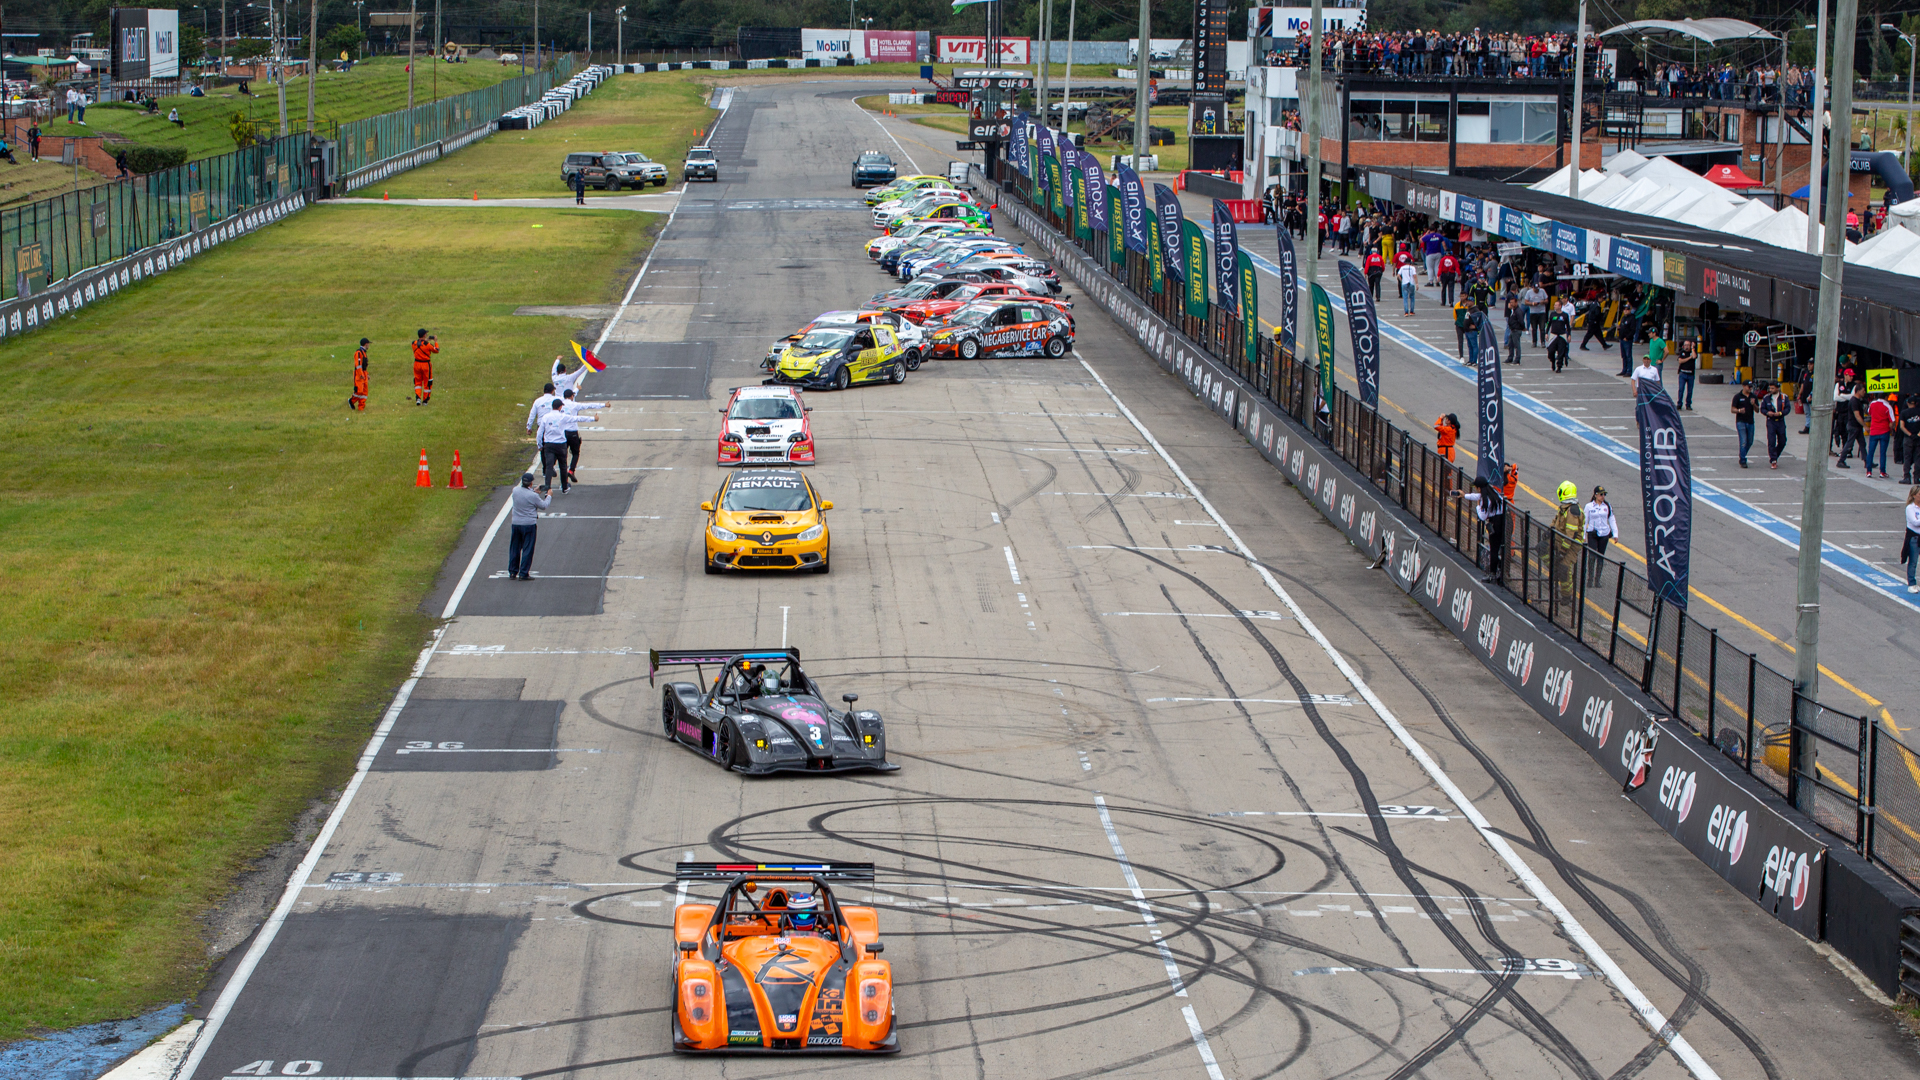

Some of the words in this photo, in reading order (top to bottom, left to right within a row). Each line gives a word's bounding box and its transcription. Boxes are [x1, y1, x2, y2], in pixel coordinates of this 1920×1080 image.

[1200, 9, 1207, 17] 3
[1200, 19, 1206, 27] 4
[1288, 18, 1326, 30] Mol
[1331, 18, 1343, 30] 1
[816, 40, 841, 51] Mobil
[842, 40, 850, 52] 1
[1199, 30, 1206, 38] 5
[1199, 40, 1205, 48] 6
[1198, 61, 1205, 69] 8
[1199, 51, 1205, 59] 7
[960, 79, 980, 88] elf
[998, 79, 1018, 88] elf
[1196, 82, 1205, 90] 10
[1198, 72, 1204, 80] 9
[974, 125, 997, 136] elf
[1089, 166, 1104, 221] ARQUIB
[1080, 205, 1089, 230] LAKE
[1127, 181, 1143, 242] ARQUIB
[1151, 222, 1159, 251] WEST
[1165, 203, 1181, 272] ARQUIB
[1556, 239, 1562, 249] DE
[17, 249, 30, 273] WEST
[1192, 236, 1201, 273] WEST
[1221, 222, 1233, 299] ARQUIB
[1616, 257, 1622, 268] DE
[1618, 245, 1640, 261] AUTODROMO
[1573, 263, 1589, 276] 85
[1193, 274, 1202, 304] LAKE
[1244, 269, 1253, 309] WEST
[1282, 250, 1294, 337] ARQUIB
[1704, 268, 1716, 296] CR
[1732, 275, 1750, 292] RACING
[1739, 296, 1750, 307] TEAM
[982, 329, 1030, 348] MEGASERVICE
[1032, 326, 1047, 340] CAR
[1318, 304, 1329, 348] WEST
[884, 345, 892, 356] elf
[1351, 290, 1376, 390] ARQUIB
[1485, 346, 1499, 467] ARQUIB
[732, 481, 799, 489] RENAULT
[1323, 478, 1333, 506] elf
[1341, 494, 1351, 523] elf
[1653, 427, 1678, 580] ARQUIB
[1360, 511, 1371, 541] elf
[1647, 522, 1655, 565] GRUPO
[1426, 565, 1440, 600] elf
[1452, 588, 1466, 624] elf
[1478, 614, 1494, 650] elf
[1507, 640, 1523, 677] elf
[1543, 667, 1561, 707] elf
[770, 702, 823, 710] LAVAFANTE
[1583, 696, 1602, 738] elf
[677, 718, 701, 742] LAVAFANTE
[810, 727, 821, 740] 3
[405, 741, 465, 750] 36
[1659, 765, 1682, 811] elf
[1379, 805, 1435, 814] 37
[1707, 804, 1737, 852] elf
[330, 872, 404, 883] 38
[1765, 845, 1796, 896] elf
[1497, 958, 1578, 971] 39
[231, 1060, 324, 1076] 40
